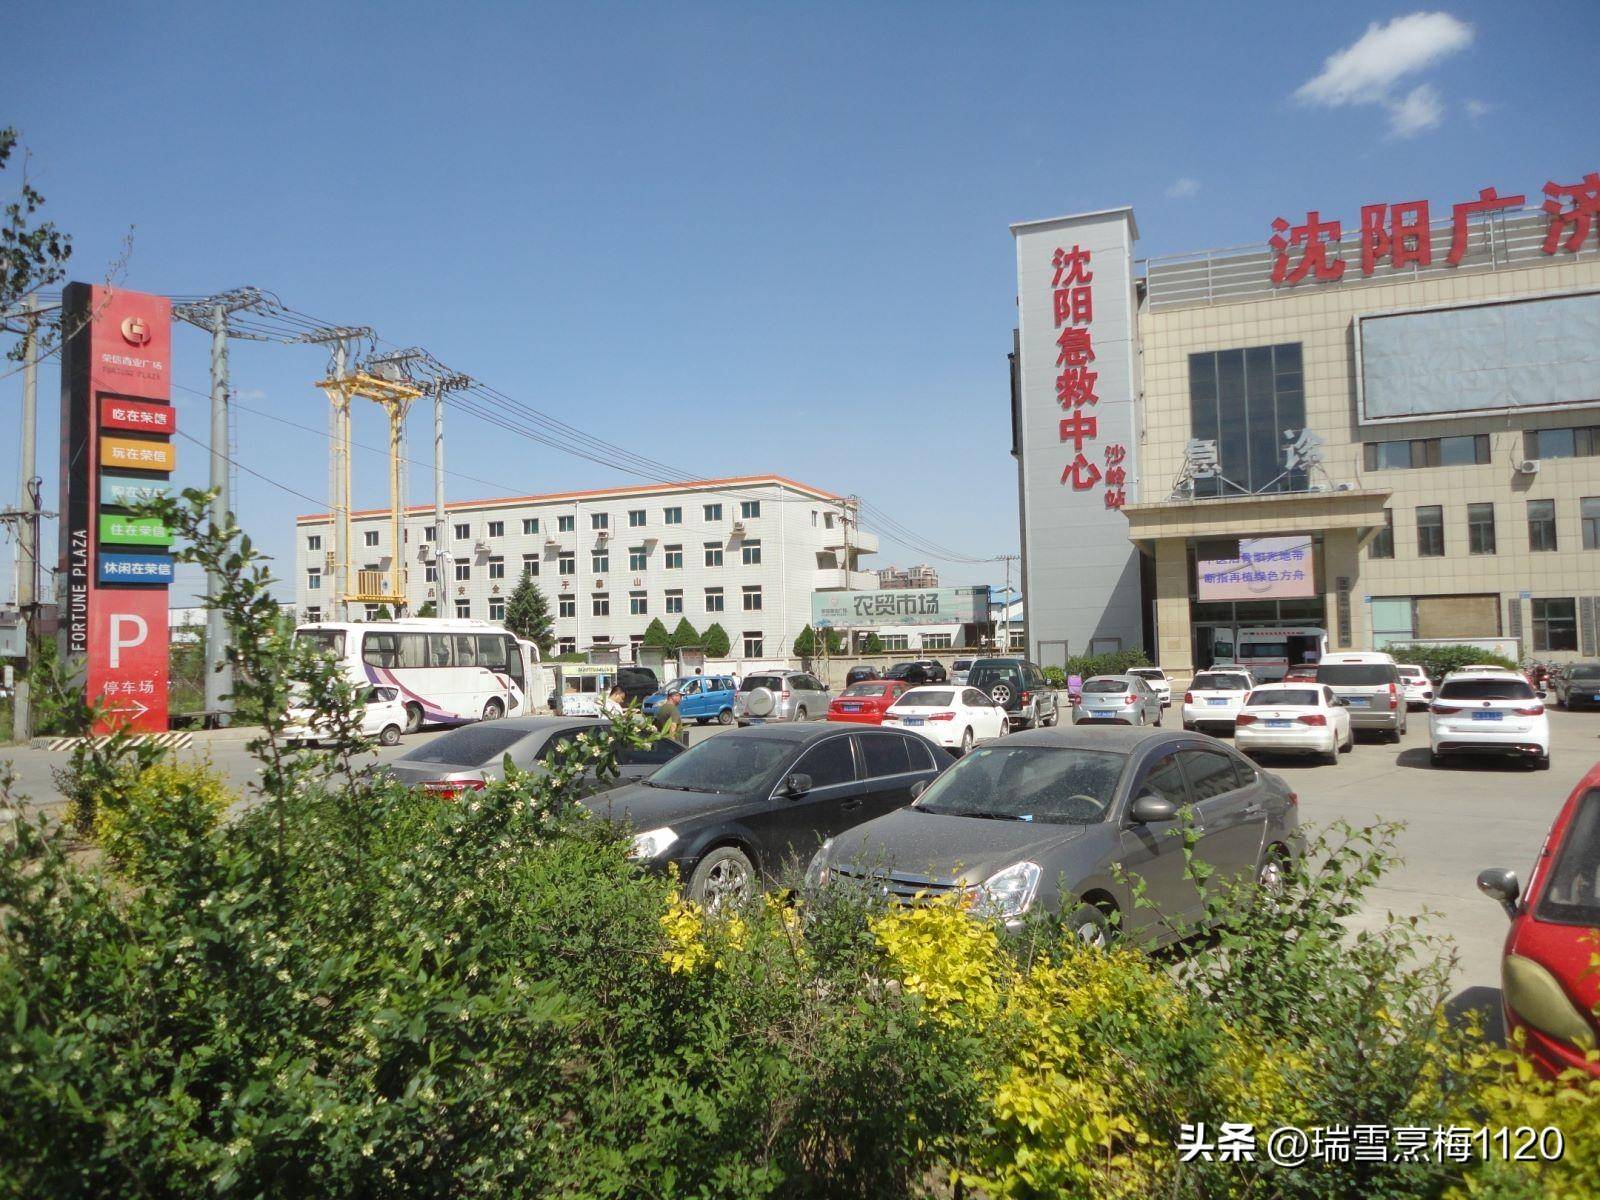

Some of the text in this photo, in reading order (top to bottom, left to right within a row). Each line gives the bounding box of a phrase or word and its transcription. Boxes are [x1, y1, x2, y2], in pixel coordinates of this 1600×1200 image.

[1268, 172, 1600, 288] 沈阳广济
[1052, 245, 1102, 492] 沈阳急救中心
[111, 446, 167, 462] 玩在荣信
[1104, 444, 1127, 510] 沙岭站
[110, 523, 166, 538] 住在荣信
[104, 561, 171, 576] 休闲在荣信
[71, 529, 88, 651] FORTUNE PLAZA
[853, 592, 939, 617] 农贸市场
[109, 613, 148, 669] P
[103, 680, 154, 695] 停车场
